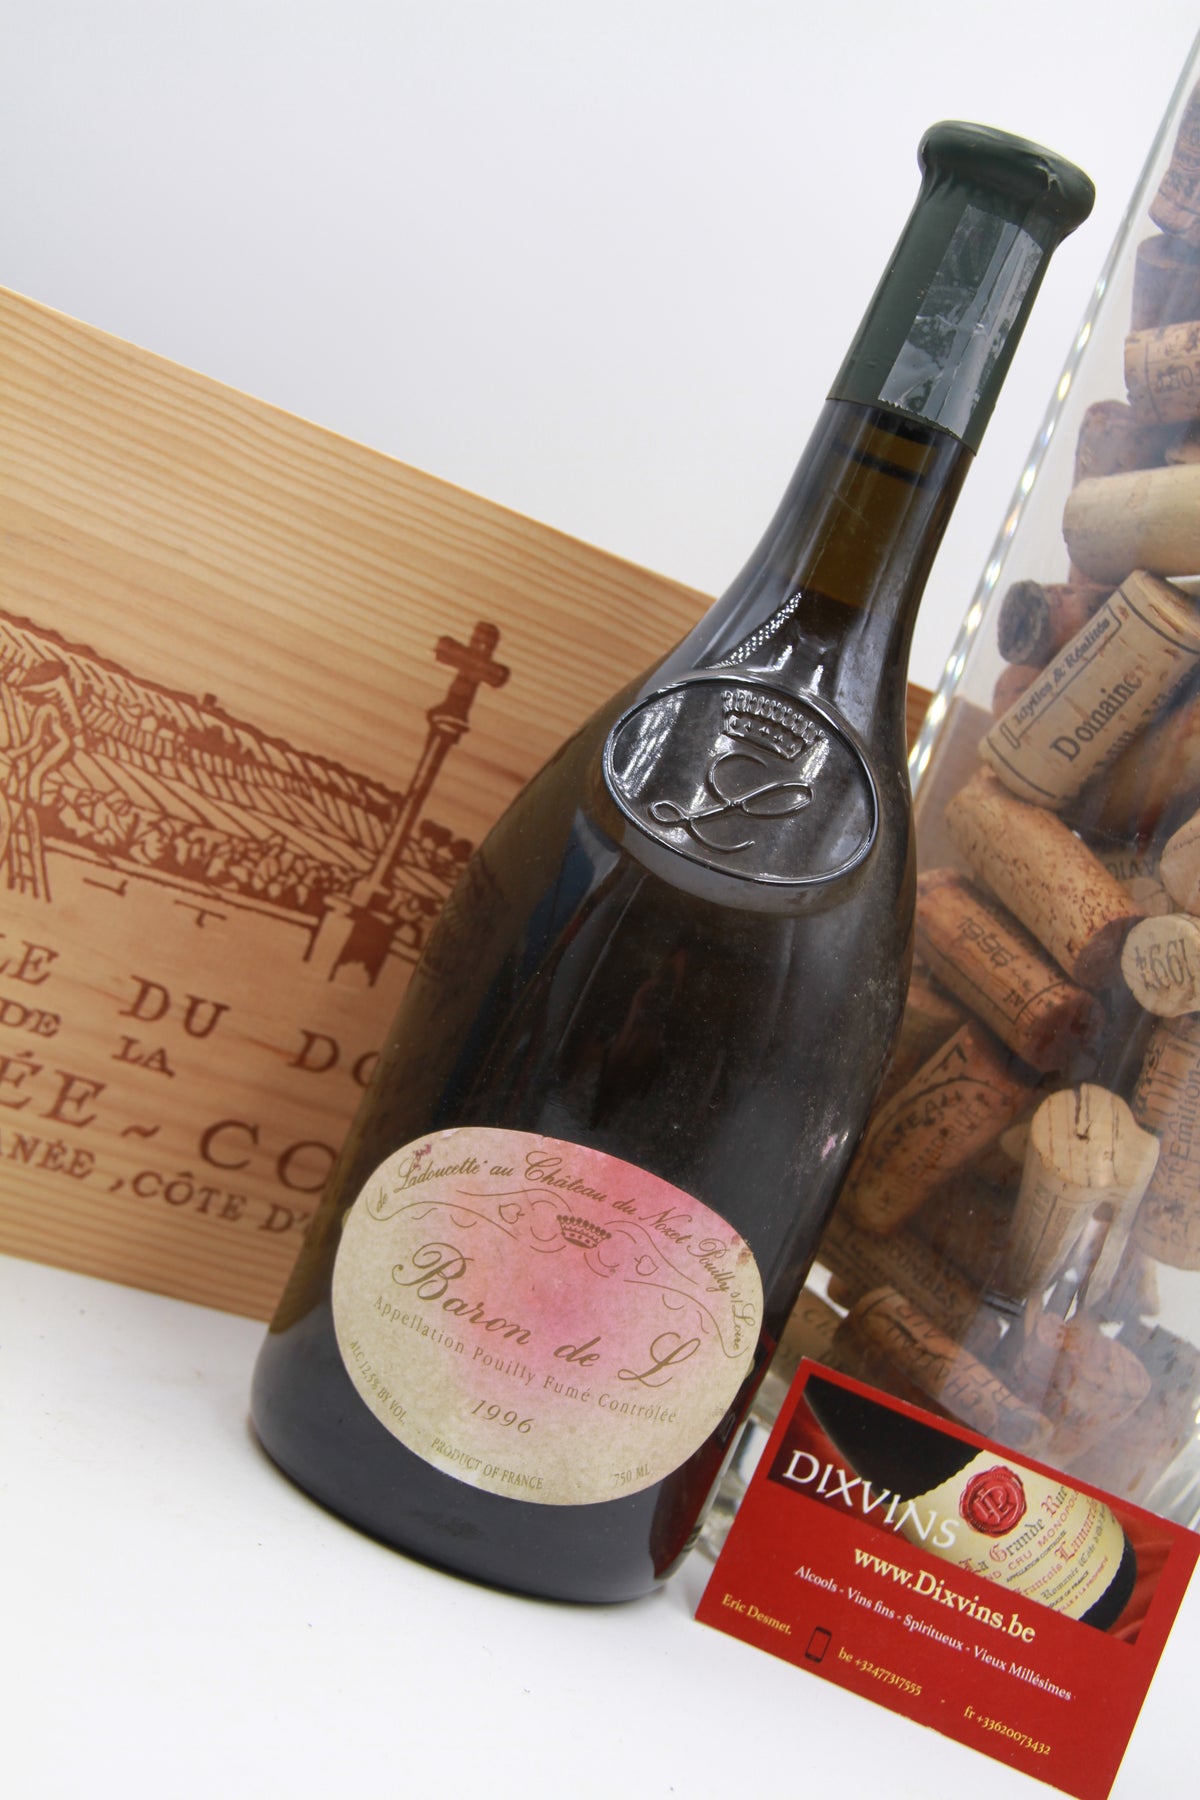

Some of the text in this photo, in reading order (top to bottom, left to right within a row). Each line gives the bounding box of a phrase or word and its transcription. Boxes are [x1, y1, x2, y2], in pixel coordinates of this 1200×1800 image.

[119, 974, 231, 1039] DU
[0, 997, 176, 1078] DE LA
[0, 1132, 97, 1180] NÉE
[489, 1164, 515, 1178] au
[524, 1150, 608, 1203] Château
[611, 1198, 638, 1216] du
[637, 1206, 693, 1245] Nozet
[686, 1237, 737, 1293] Pouilly
[391, 1242, 702, 1388] Baron de L
[373, 1295, 678, 1425] Appellation Pouilly Fumé Contrôlée
[377, 1386, 393, 1404] BY
[470, 1398, 537, 1435] 1996
[430, 1437, 545, 1492] PRODUCT OF FRANCE
[614, 1463, 651, 1487] 750 ML
[782, 1449, 961, 1549] DIXVINS
[988, 1518, 1047, 1563] Grande
[1007, 1550, 1033, 1571] CRU
[721, 1593, 747, 1614] Eric
[854, 1547, 1037, 1644] www.Dixvins.be
[794, 1565, 839, 1593] Alcools
[847, 1586, 873, 1609] Vins
[873, 1600, 896, 1620] fins
[902, 1613, 965, 1652] Spiritueux
[974, 1645, 1008, 1672] Vieux
[1007, 1661, 1073, 1701] Millésimes
[837, 1646, 854, 1664] be
[963, 1704, 1052, 1756] fr +33620073432
